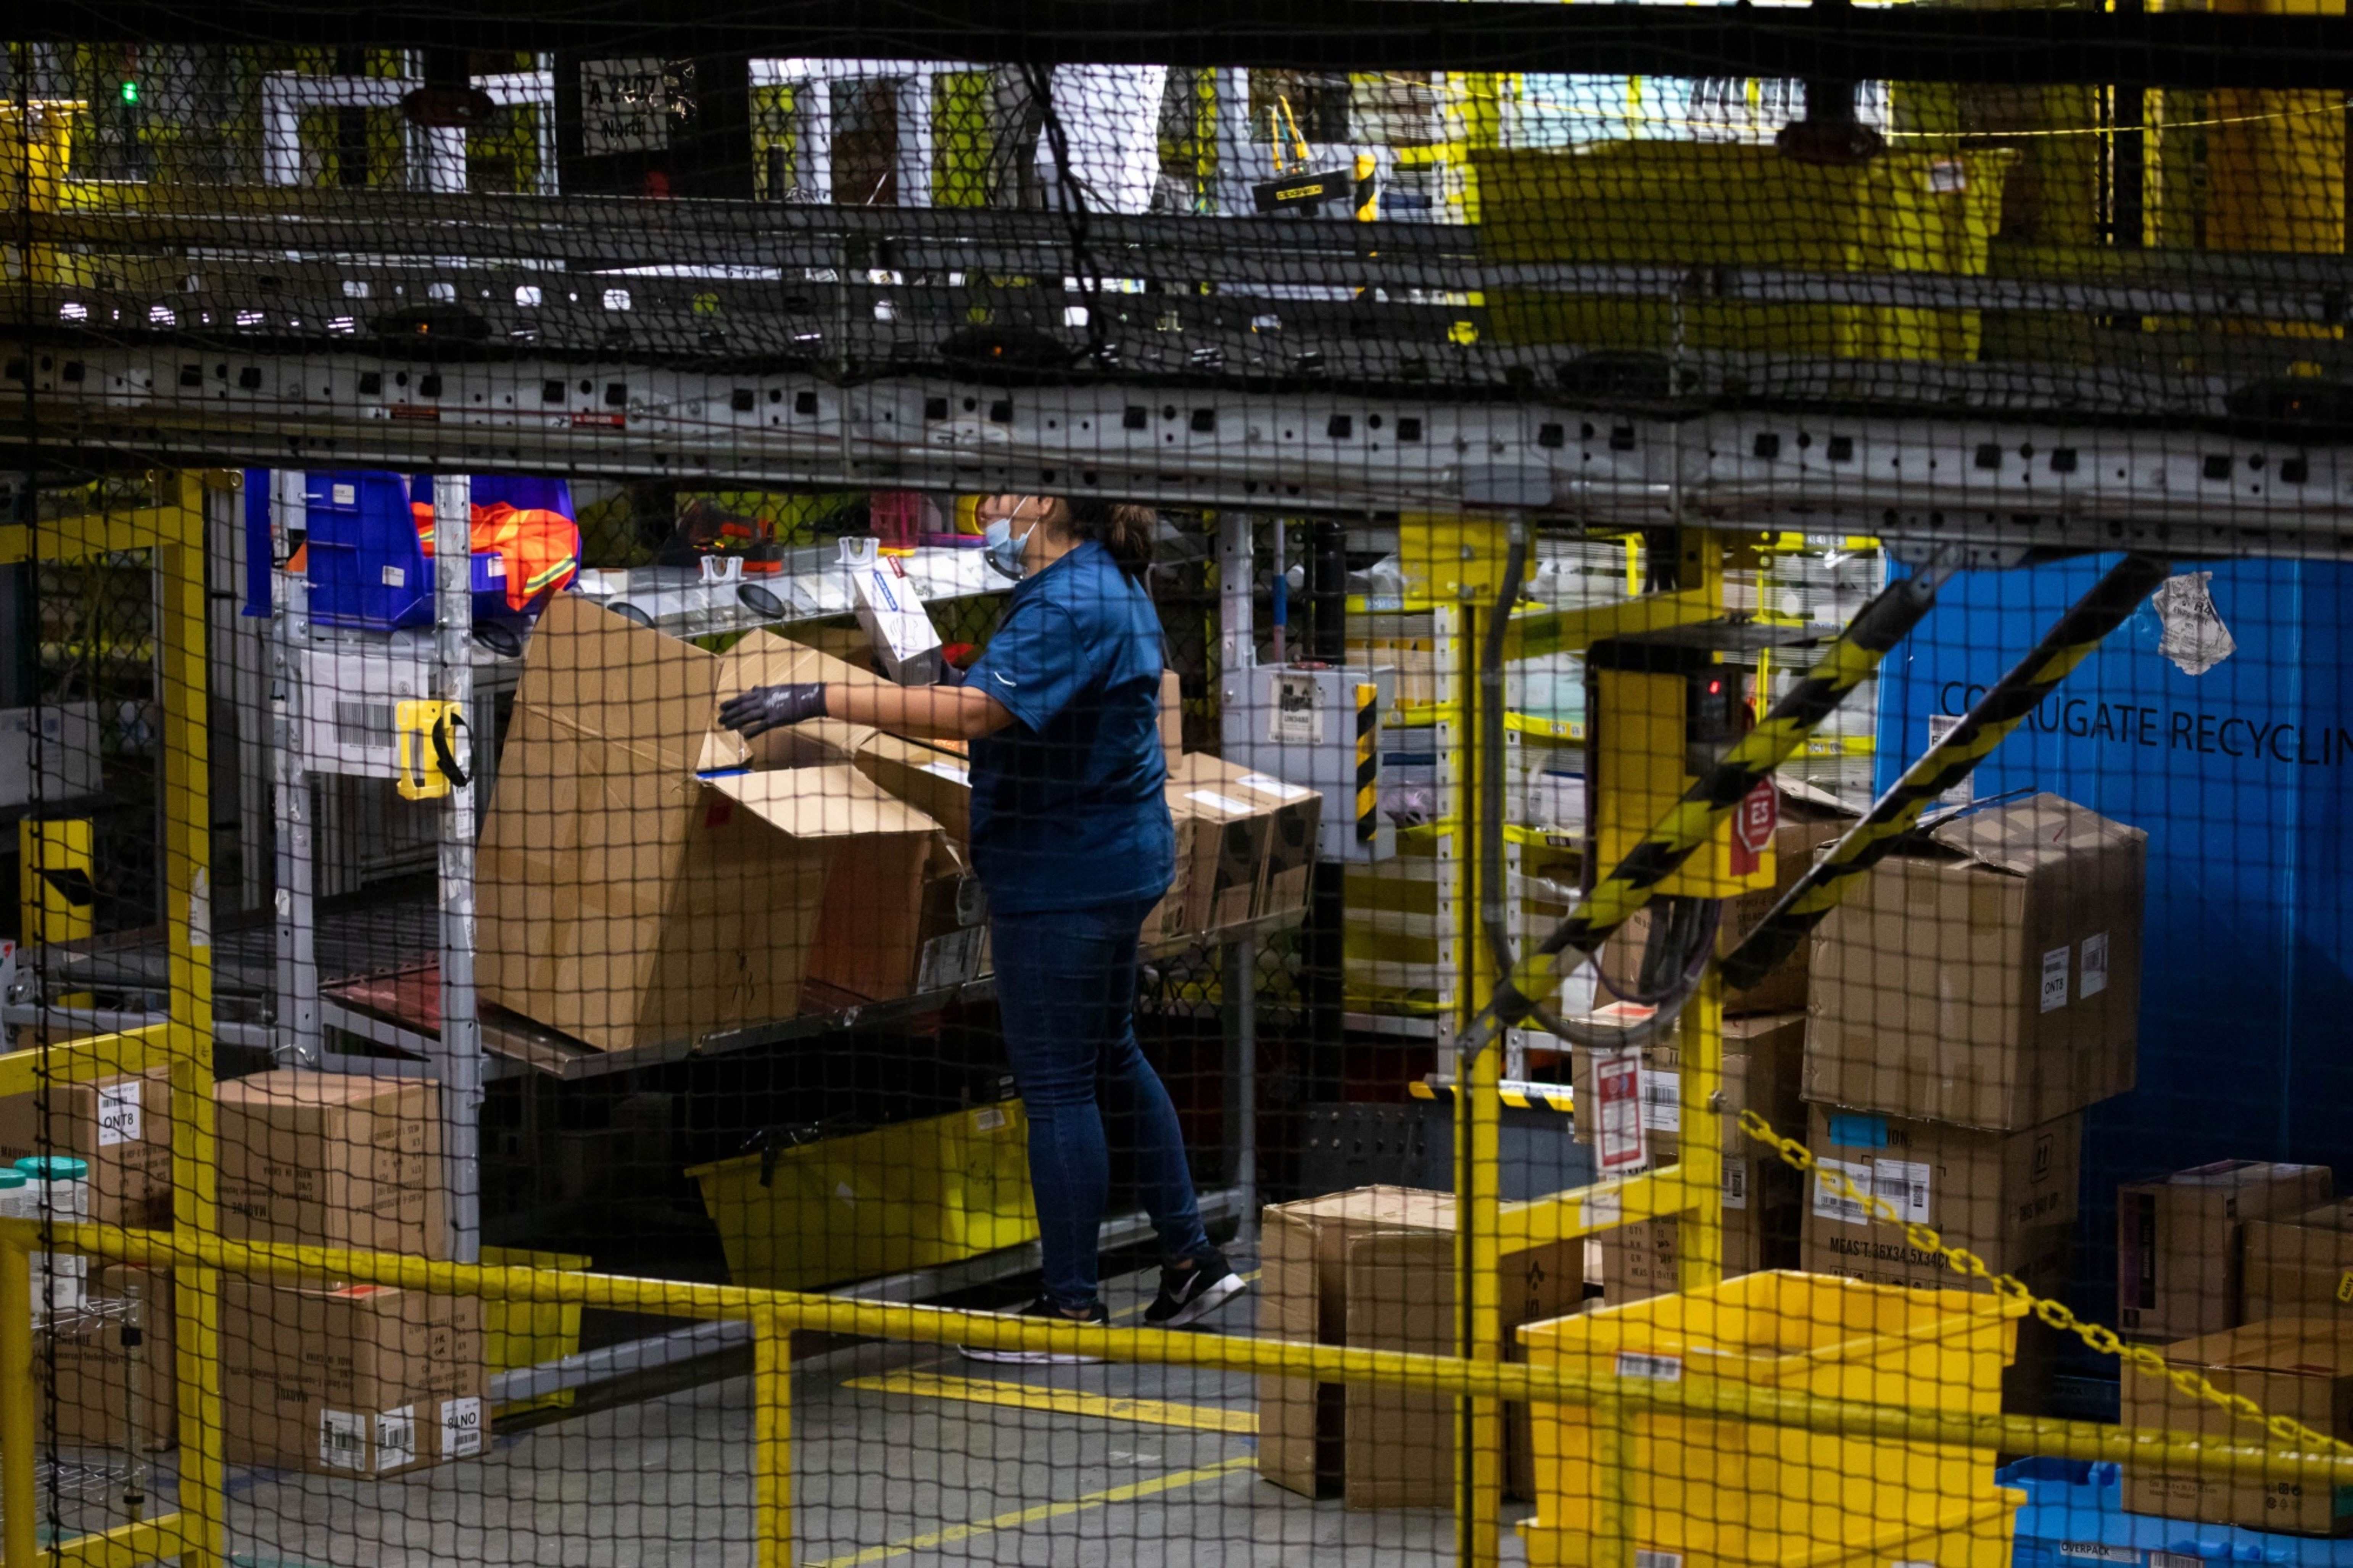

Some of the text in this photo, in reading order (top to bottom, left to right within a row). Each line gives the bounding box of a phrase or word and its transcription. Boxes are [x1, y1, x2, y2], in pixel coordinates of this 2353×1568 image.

[590, 80, 603, 104] A
[603, 116, 645, 138] North
[1941, 680, 2158, 747] COUGATE
[2045, 977, 2063, 994] ONT8
[105, 1113, 134, 1128] ONT8
[448, 1412, 476, 1430] ONT8
[2061, 1542, 2110, 1557] OVERPACK
